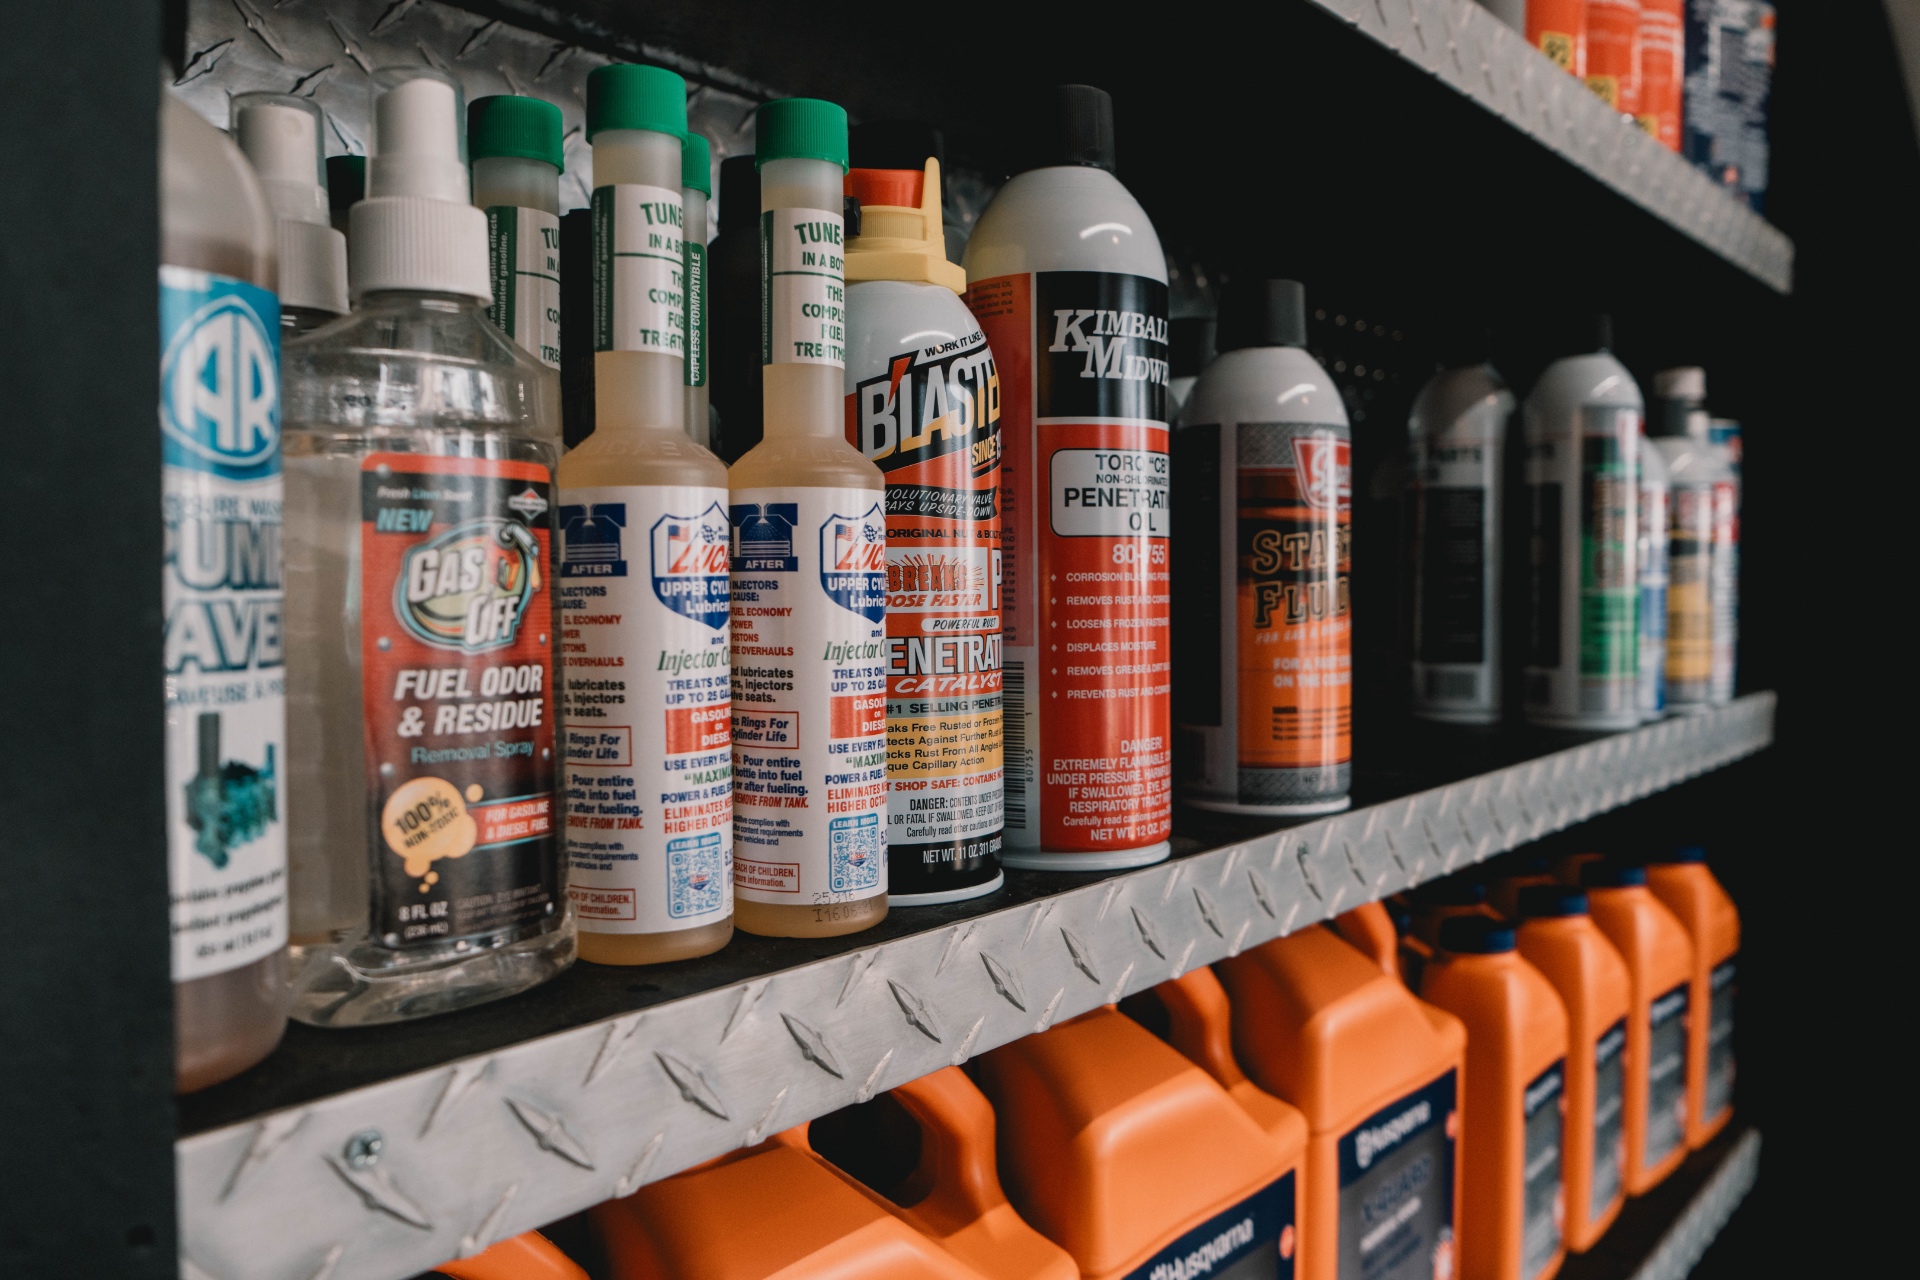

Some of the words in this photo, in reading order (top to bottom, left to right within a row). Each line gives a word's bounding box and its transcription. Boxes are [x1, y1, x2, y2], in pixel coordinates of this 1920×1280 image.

[794, 222, 843, 245] TUNE-
[498, 232, 508, 276] gasoline.
[802, 252, 815, 266] IN
[691, 252, 701, 325] COMPATIBLE
[826, 285, 843, 303] THE
[821, 323, 844, 343] FUEL
[925, 339, 958, 357] WORK
[960, 337, 968, 348] IT
[972, 434, 996, 466] SINCE
[919, 502, 991, 517] UPSIDE-DOWN
[376, 508, 434, 534] NEW
[1129, 511, 1157, 532] OL
[886, 528, 950, 539] ORIGINAL
[571, 564, 613, 575] AFTER
[745, 560, 784, 569] AFTER
[408, 549, 486, 603] GAS
[660, 581, 708, 597] UPPER
[732, 580, 779, 590] INJECTORS
[828, 577, 869, 591] UPPER
[930, 593, 982, 608] FASTER
[1067, 596, 1113, 605] REMOVES
[1115, 595, 1136, 604] RUST
[747, 607, 792, 617] ECONOMY
[464, 594, 521, 647] OFF
[573, 615, 622, 626] ECONOMY
[933, 619, 980, 630] POWERFUL
[1067, 619, 1112, 629] LOOSENS
[742, 646, 794, 656] OVERHAULS
[823, 639, 878, 666] Injector
[1067, 642, 1119, 652] DISPLACES
[569, 657, 624, 668] OVERHAULS
[658, 649, 718, 676] Injector
[740, 667, 794, 679] lubricates
[832, 667, 871, 680] TREATS
[1067, 665, 1113, 676] REMOVES
[1115, 664, 1146, 675] GREASE
[394, 669, 467, 702] FUEL
[480, 665, 543, 696] ODOR
[568, 679, 626, 691] lubricates
[667, 678, 712, 692] TREATS
[745, 679, 794, 692] injectors
[831, 681, 848, 692] UP
[851, 680, 864, 691] TO
[1273, 673, 1293, 688] ON
[574, 692, 626, 705] injectors
[689, 691, 704, 703] TO
[745, 692, 776, 703] seats.
[1067, 689, 1116, 699] PREVENTS
[574, 707, 607, 719] seats.
[886, 704, 902, 714] #1
[910, 700, 968, 714] SELLING
[397, 706, 426, 738] &
[433, 698, 543, 736] RESIDUE
[741, 716, 766, 729] Rings
[769, 718, 788, 729] For
[939, 719, 971, 731] Rusted
[569, 732, 596, 747] Rings
[600, 733, 620, 746] For
[701, 732, 730, 747] DIESEL
[766, 731, 787, 742] Life
[919, 734, 957, 747] Against
[961, 731, 987, 742] Further
[410, 742, 492, 766] Removal
[494, 739, 535, 760] Spray
[596, 748, 619, 760] Life
[828, 743, 849, 755] USE
[851, 740, 876, 752] EVERY
[969, 744, 978, 754] All
[664, 759, 688, 771] USE
[691, 755, 719, 769] EVERY
[743, 756, 763, 767] Pour
[766, 757, 800, 768] entire
[913, 759, 957, 771] Capillary
[1054, 758, 1117, 770] EXTREMELY
[1120, 752, 1163, 769] FLAMMABLE
[572, 774, 594, 788] Pour
[597, 776, 634, 788] entire
[735, 768, 756, 780] bottle
[758, 769, 778, 781] into
[781, 770, 802, 781] fuel
[825, 771, 860, 785] POWER
[870, 768, 883, 780] FUEL
[1047, 772, 1086, 785] UNDER
[744, 781, 764, 793] after
[771, 784, 808, 797] fueling.
[895, 781, 927, 792] SHOP
[931, 779, 960, 790] SAFE:
[963, 772, 996, 787] CONTAINS
[589, 788, 609, 801] into
[613, 788, 636, 801] fuel
[661, 792, 701, 805] POWER
[711, 786, 726, 798] FUEL
[828, 785, 881, 800] ELIMINATES
[1069, 787, 1078, 799] IF
[1082, 783, 1144, 799] SWALLOWED.
[735, 792, 757, 806] REMOVE
[759, 795, 781, 808] FROM
[784, 797, 809, 808] TANK.
[827, 799, 867, 814] HIGHER
[910, 797, 948, 811] DANGER:
[950, 795, 978, 809] CONTENTS
[1070, 797, 1139, 813] RESPIRATORY
[394, 791, 452, 836] 100%
[485, 809, 508, 823] FOR
[510, 801, 549, 820] GASOLINE
[574, 802, 595, 815] after
[598, 803, 643, 817] fueling.
[664, 801, 723, 820] ELIMINATES
[894, 815, 904, 825] OR
[907, 812, 926, 825] FATAL
[929, 812, 934, 823] IF
[937, 808, 974, 823] SWALLOWED.
[590, 816, 614, 829] FROM
[617, 818, 644, 830] TANK.
[664, 817, 708, 834] HIGHER
[748, 817, 774, 828] complies
[1063, 815, 1101, 827] Carefully
[1104, 813, 1121, 825] read
[497, 822, 529, 839] DIESEL
[760, 828, 803, 838] requirements
[907, 825, 936, 838] Carefully
[938, 825, 952, 836] read
[1091, 828, 1114, 841] NET
[923, 849, 940, 864] NET
[941, 847, 957, 862] WT.
[758, 867, 796, 878] CHILDREN.
[748, 877, 786, 888] information.
[590, 890, 632, 905] CHILDREN.
